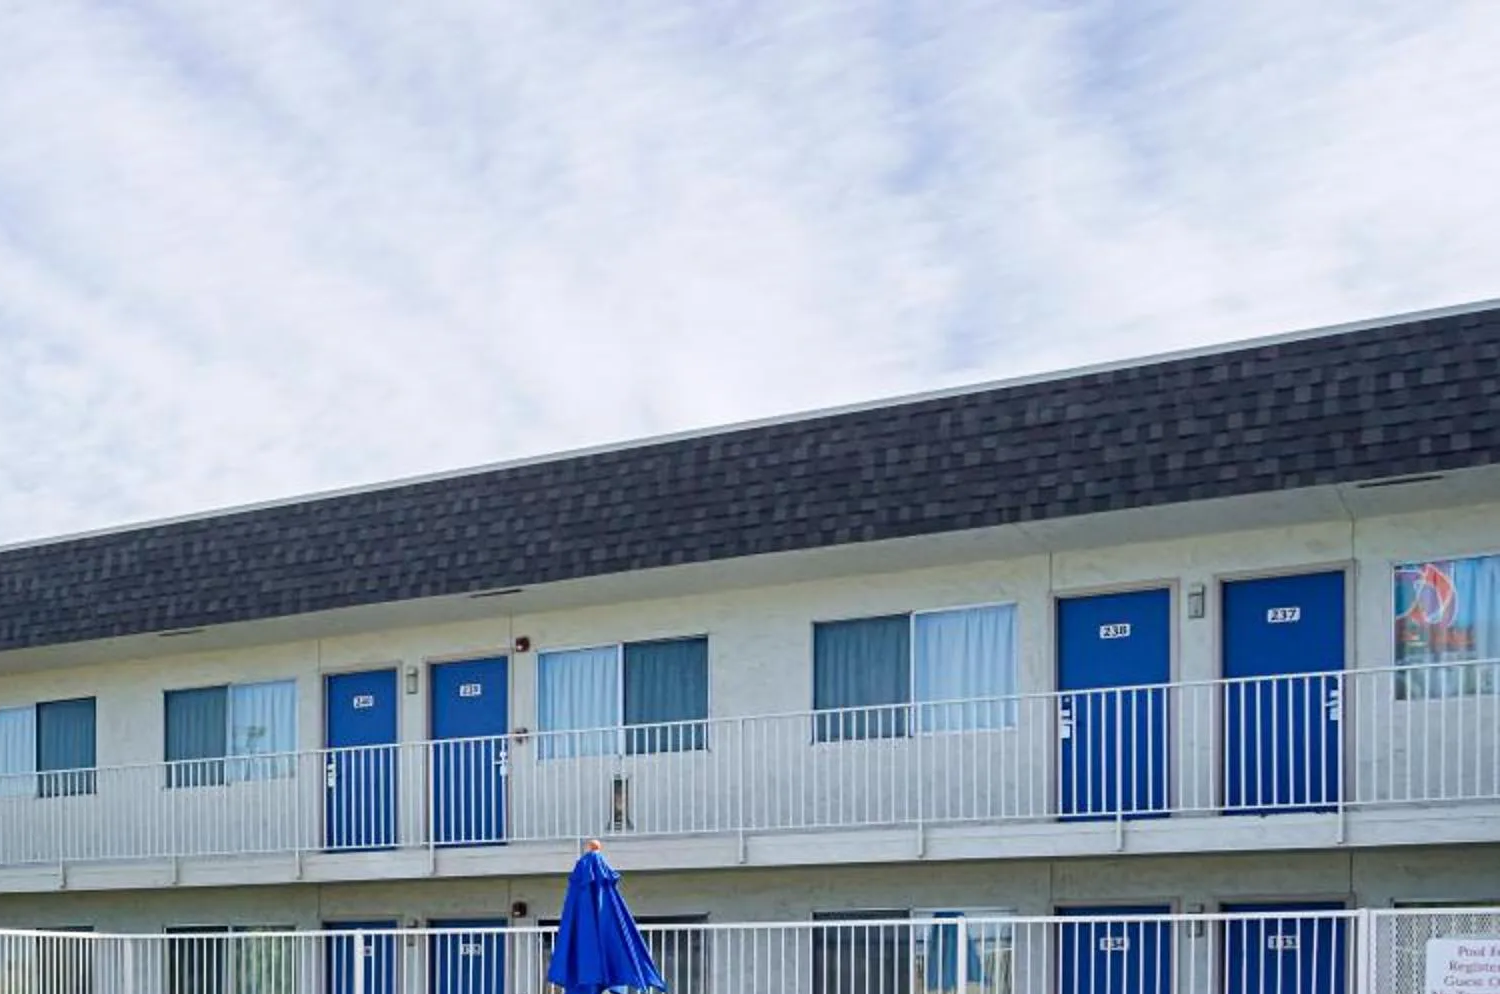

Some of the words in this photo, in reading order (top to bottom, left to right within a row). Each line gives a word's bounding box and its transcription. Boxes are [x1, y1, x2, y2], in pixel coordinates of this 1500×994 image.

[1271, 609, 1297, 621] 237
[1458, 946, 1485, 957] Pool
[1443, 975, 1485, 987] Guest
